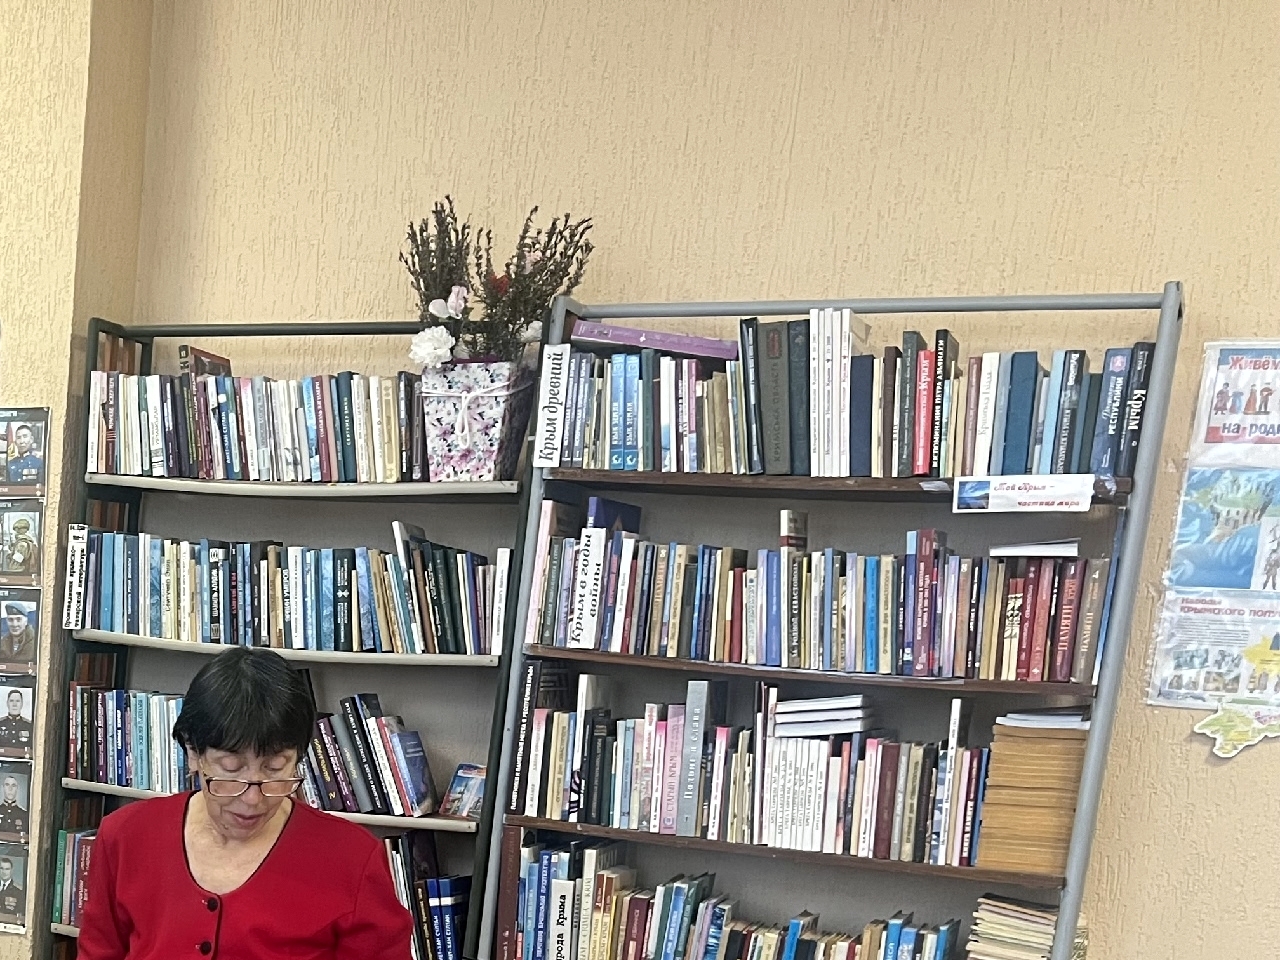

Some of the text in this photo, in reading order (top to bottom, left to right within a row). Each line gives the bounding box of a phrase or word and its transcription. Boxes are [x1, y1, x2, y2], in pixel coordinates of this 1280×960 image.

[538, 351, 564, 462] Крым древний
[1108, 376, 1124, 435] РЕСПУБЛИКИ
[1126, 389, 1147, 430] Крым
[1222, 423, 1241, 434] на
[570, 593, 586, 643] Крым
[580, 534, 592, 576] годы
[588, 562, 602, 618] войны
[666, 755, 678, 812] СТАРЫЙ КРЫМ
[556, 894, 567, 927] Крыма
